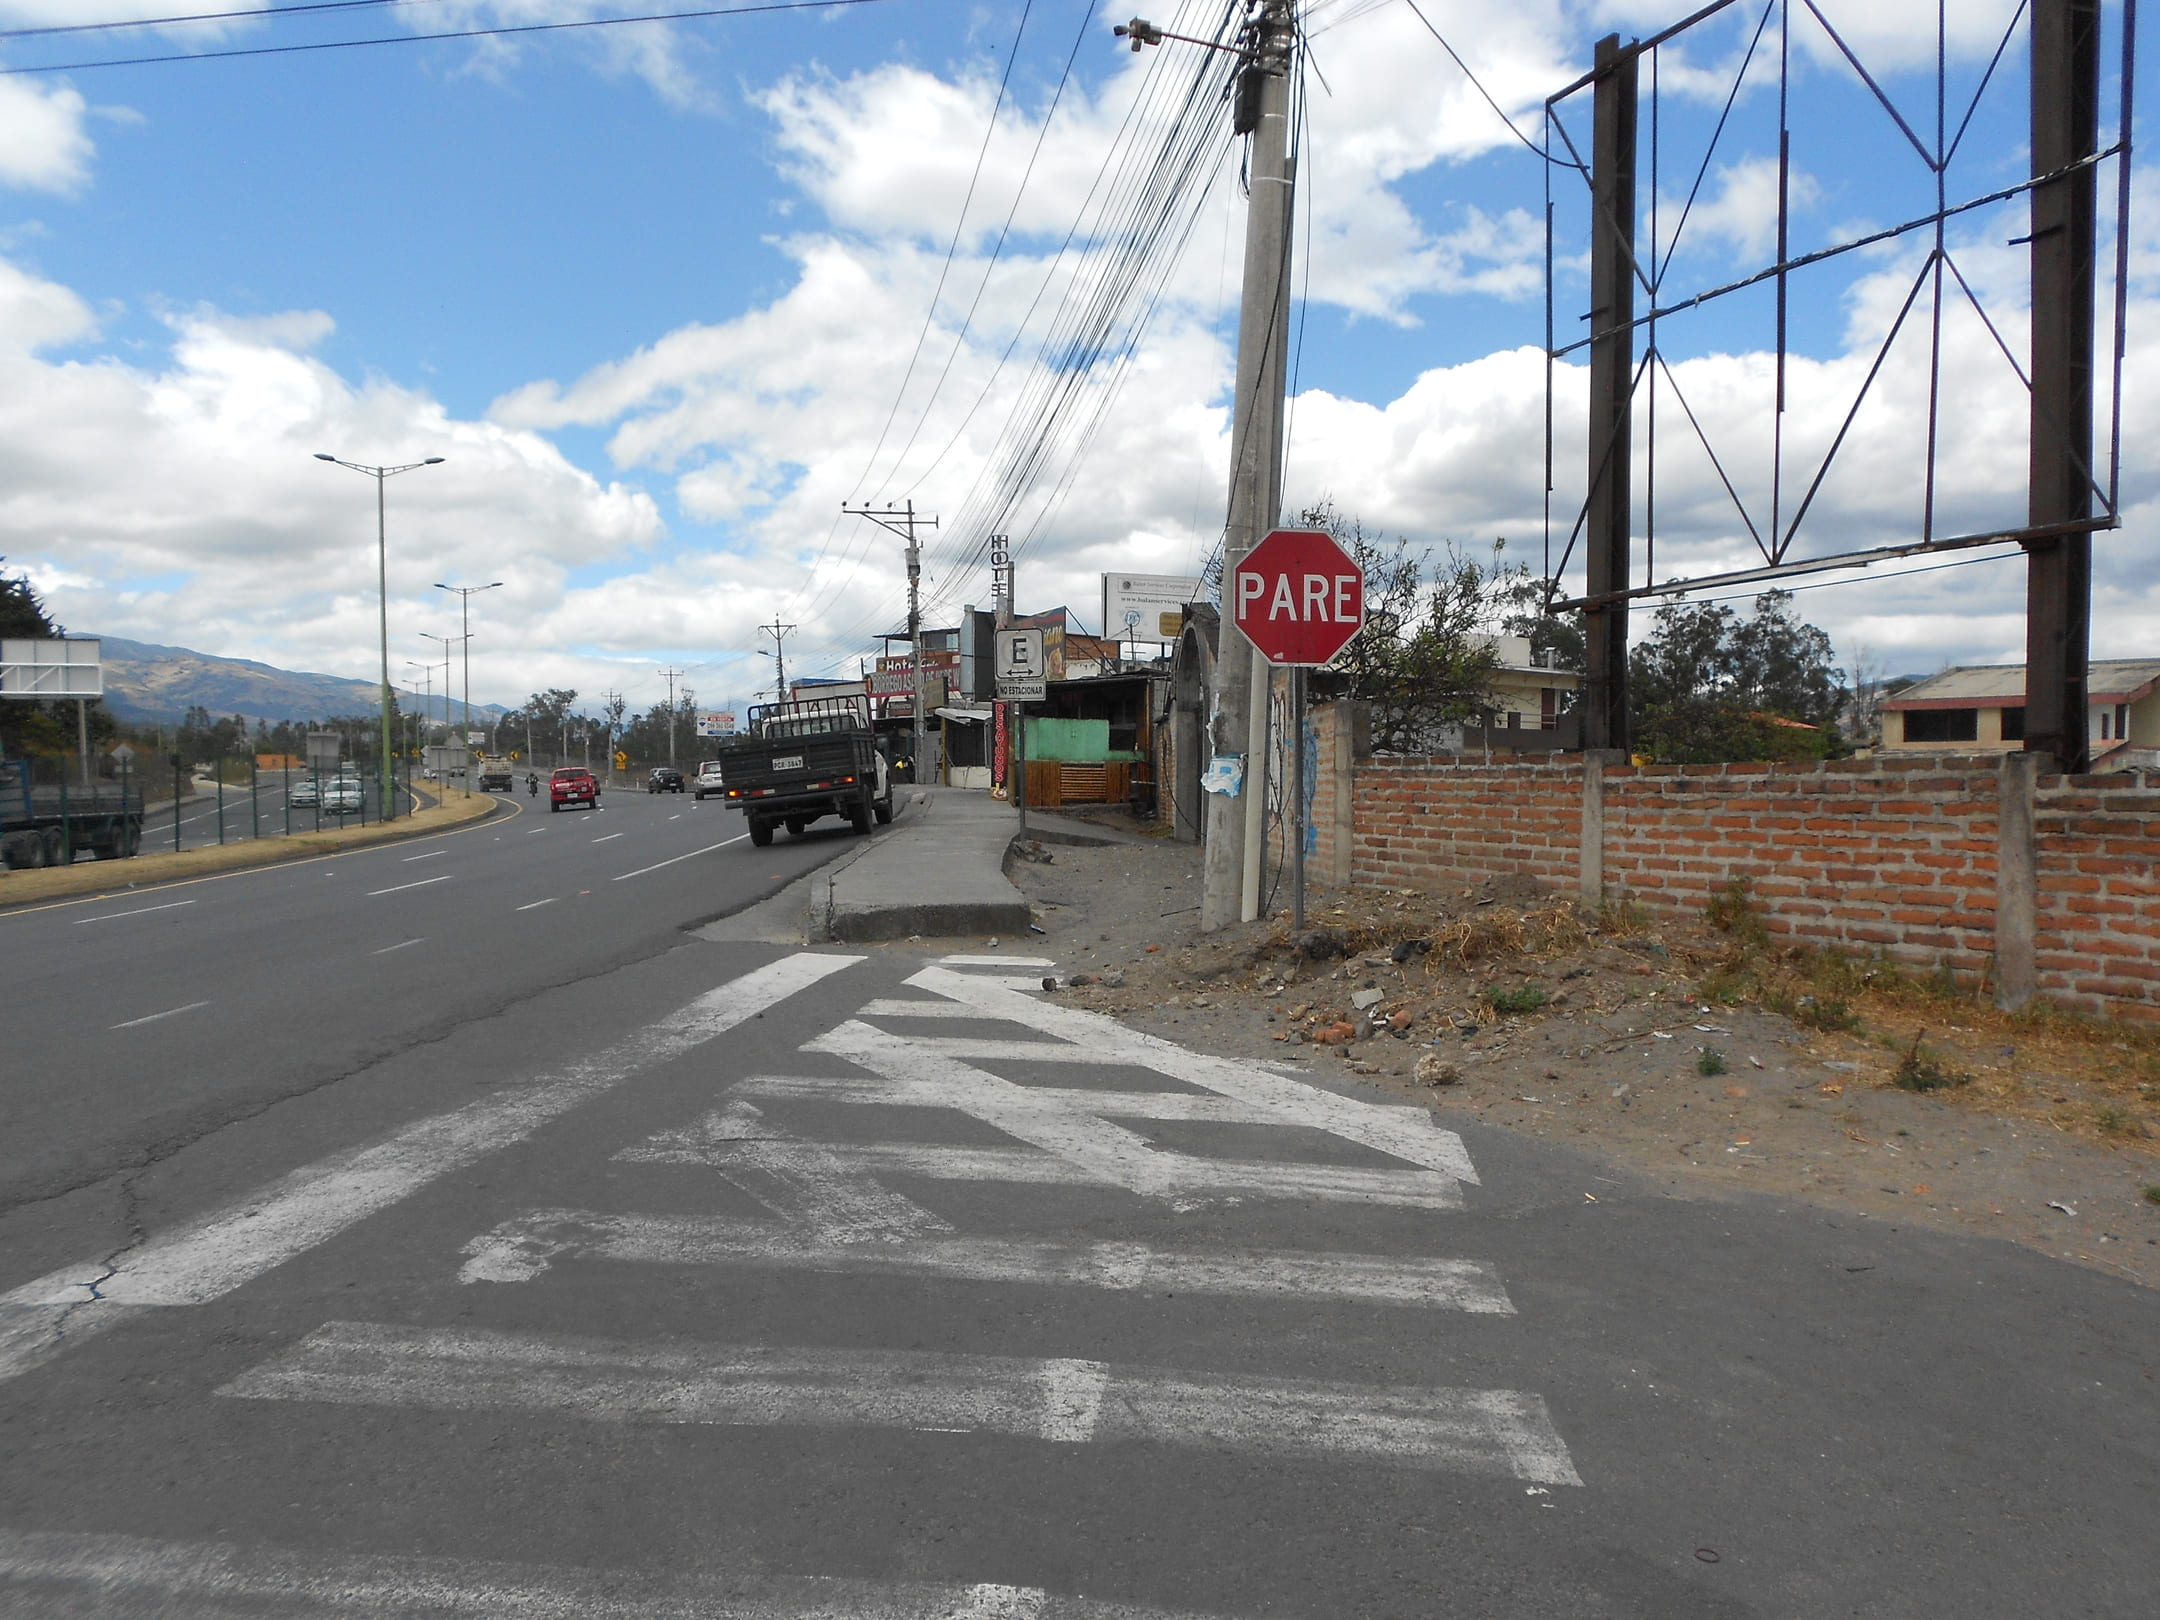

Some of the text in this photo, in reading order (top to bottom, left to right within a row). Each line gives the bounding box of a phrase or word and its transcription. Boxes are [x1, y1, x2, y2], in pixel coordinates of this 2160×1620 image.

[991, 534, 1009, 612] HOTE
[1238, 572, 1357, 623] PARE
[1012, 637, 1028, 664] E
[872, 672, 902, 694] BORREGO
[1000, 686, 1043, 695] NO ESTACIONAR
[994, 703, 1005, 782] DESAYUNOS
